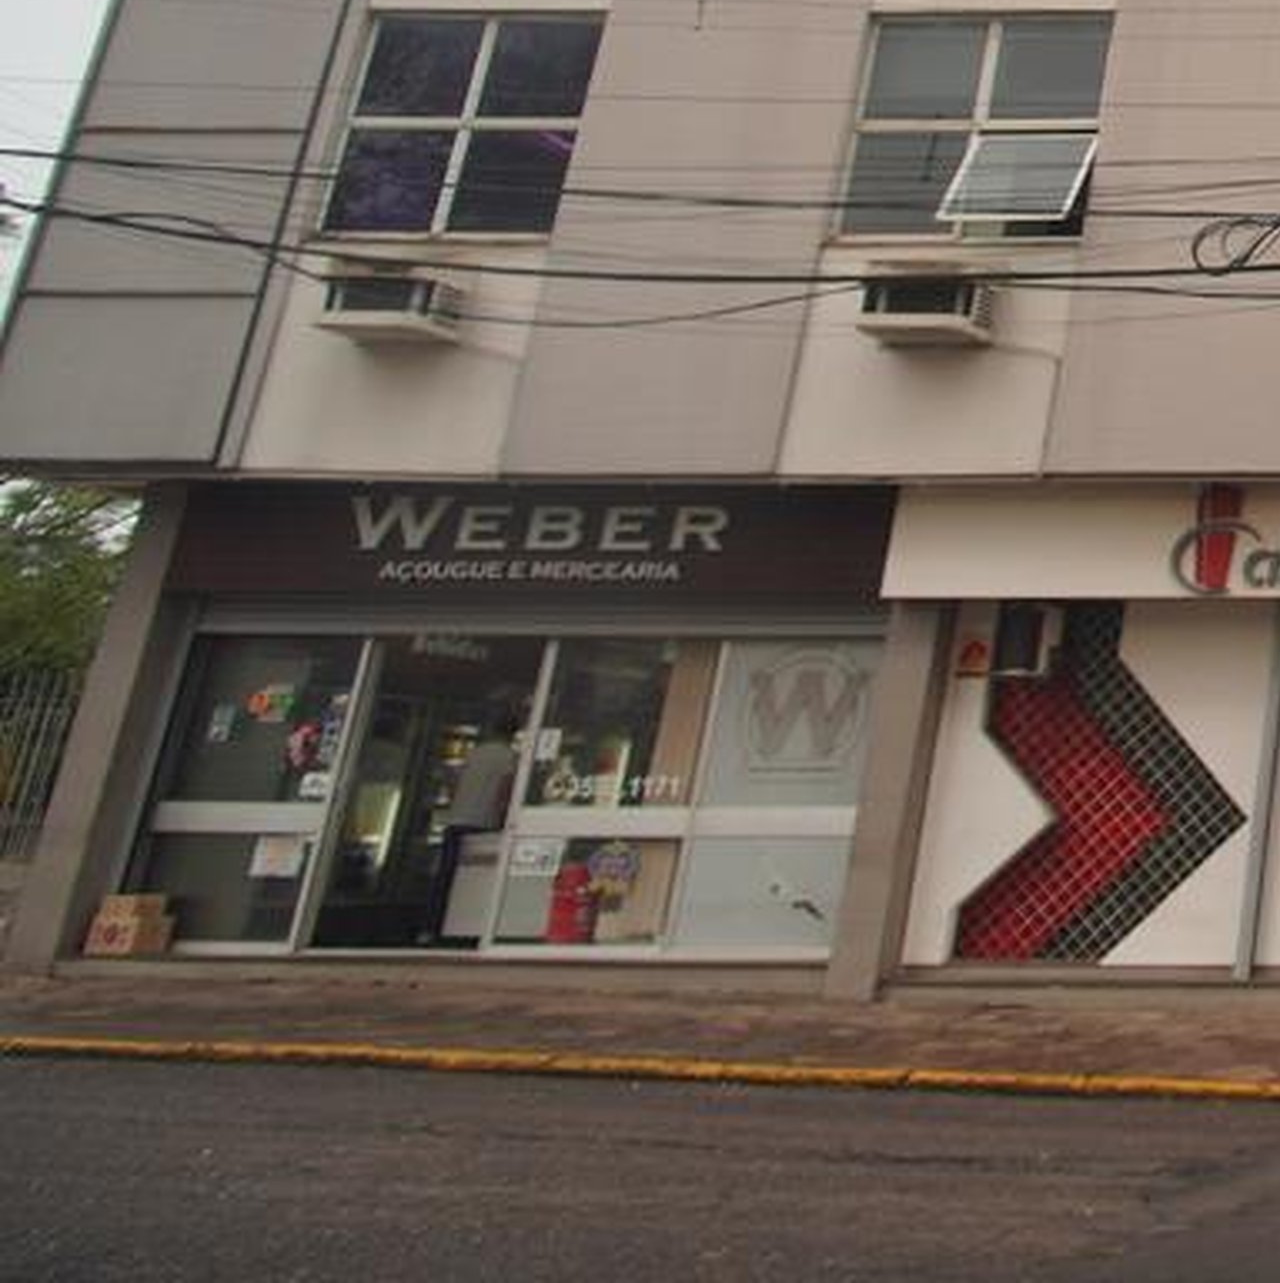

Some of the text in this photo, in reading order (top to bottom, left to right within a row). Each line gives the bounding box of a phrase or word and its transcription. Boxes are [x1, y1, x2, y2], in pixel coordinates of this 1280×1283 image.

[350, 495, 729, 552] WEBER
[379, 560, 681, 583] AÇOUGUE E MERCEARIA
